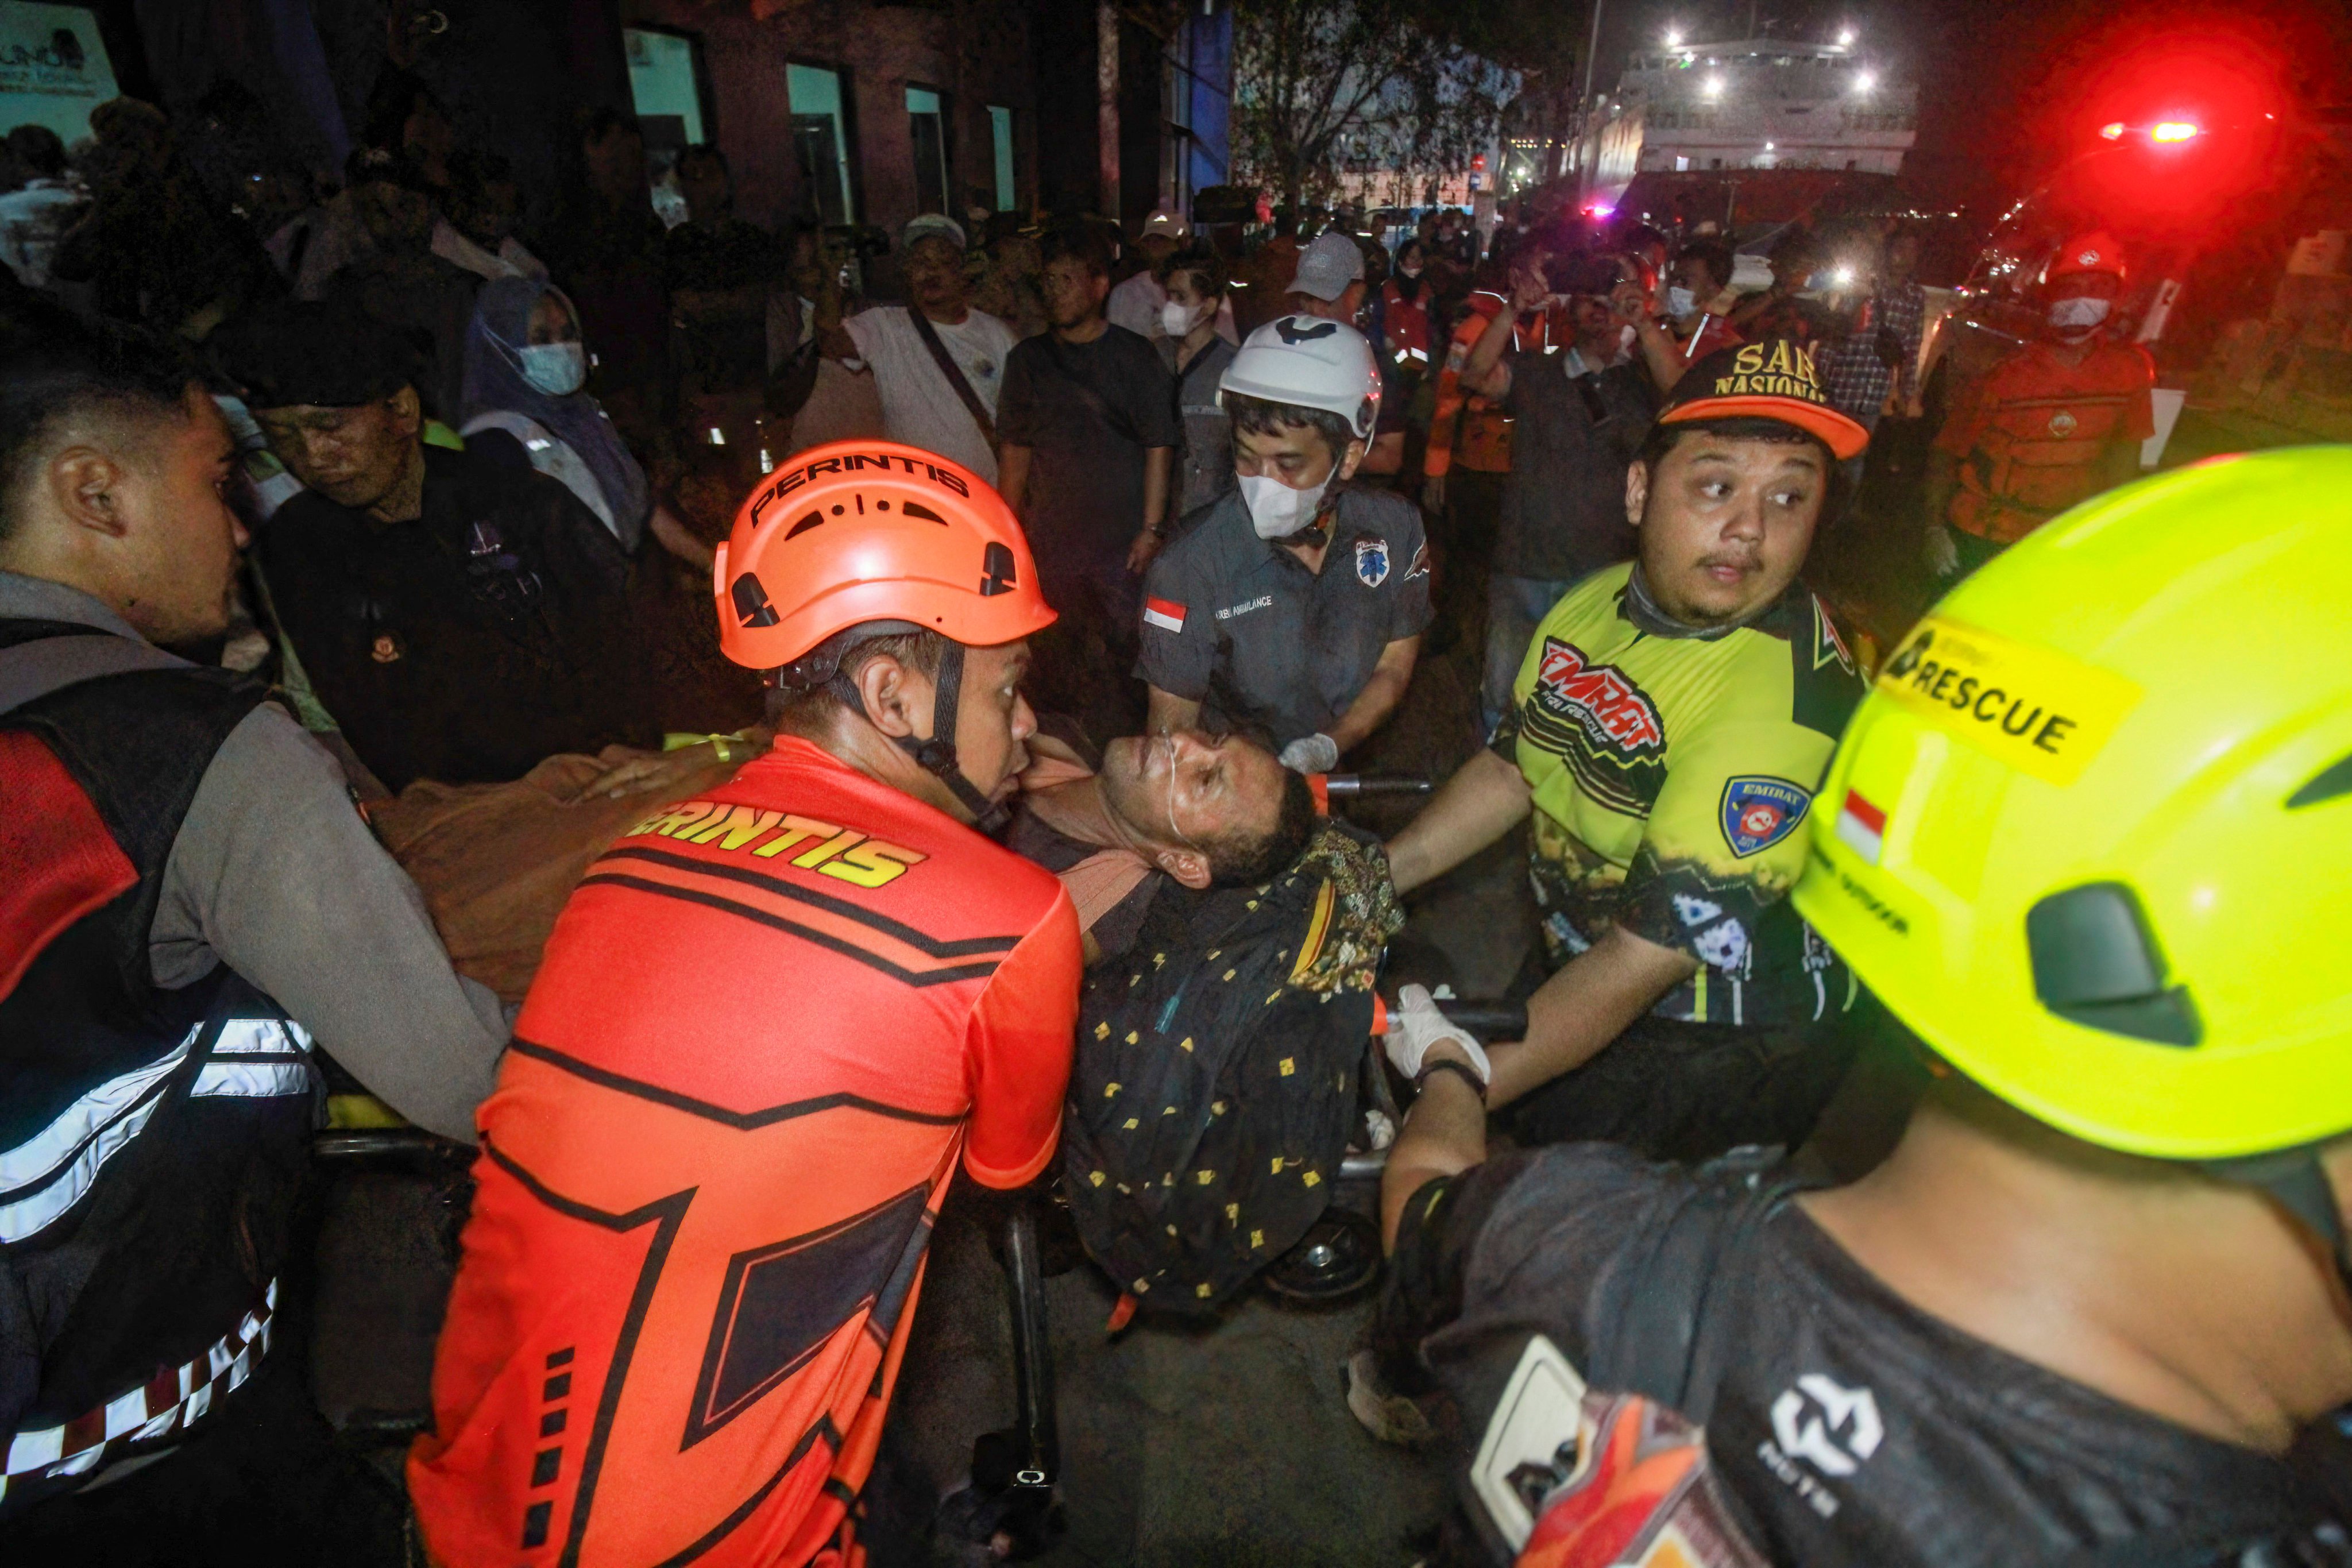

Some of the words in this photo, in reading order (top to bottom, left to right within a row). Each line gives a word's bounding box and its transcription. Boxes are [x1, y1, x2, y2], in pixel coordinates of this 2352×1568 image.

[1733, 339, 1819, 388] SAR
[750, 454, 970, 530] PERINTIS
[1912, 661, 2078, 755] RESCUE
[624, 801, 932, 889] ERINTIS
